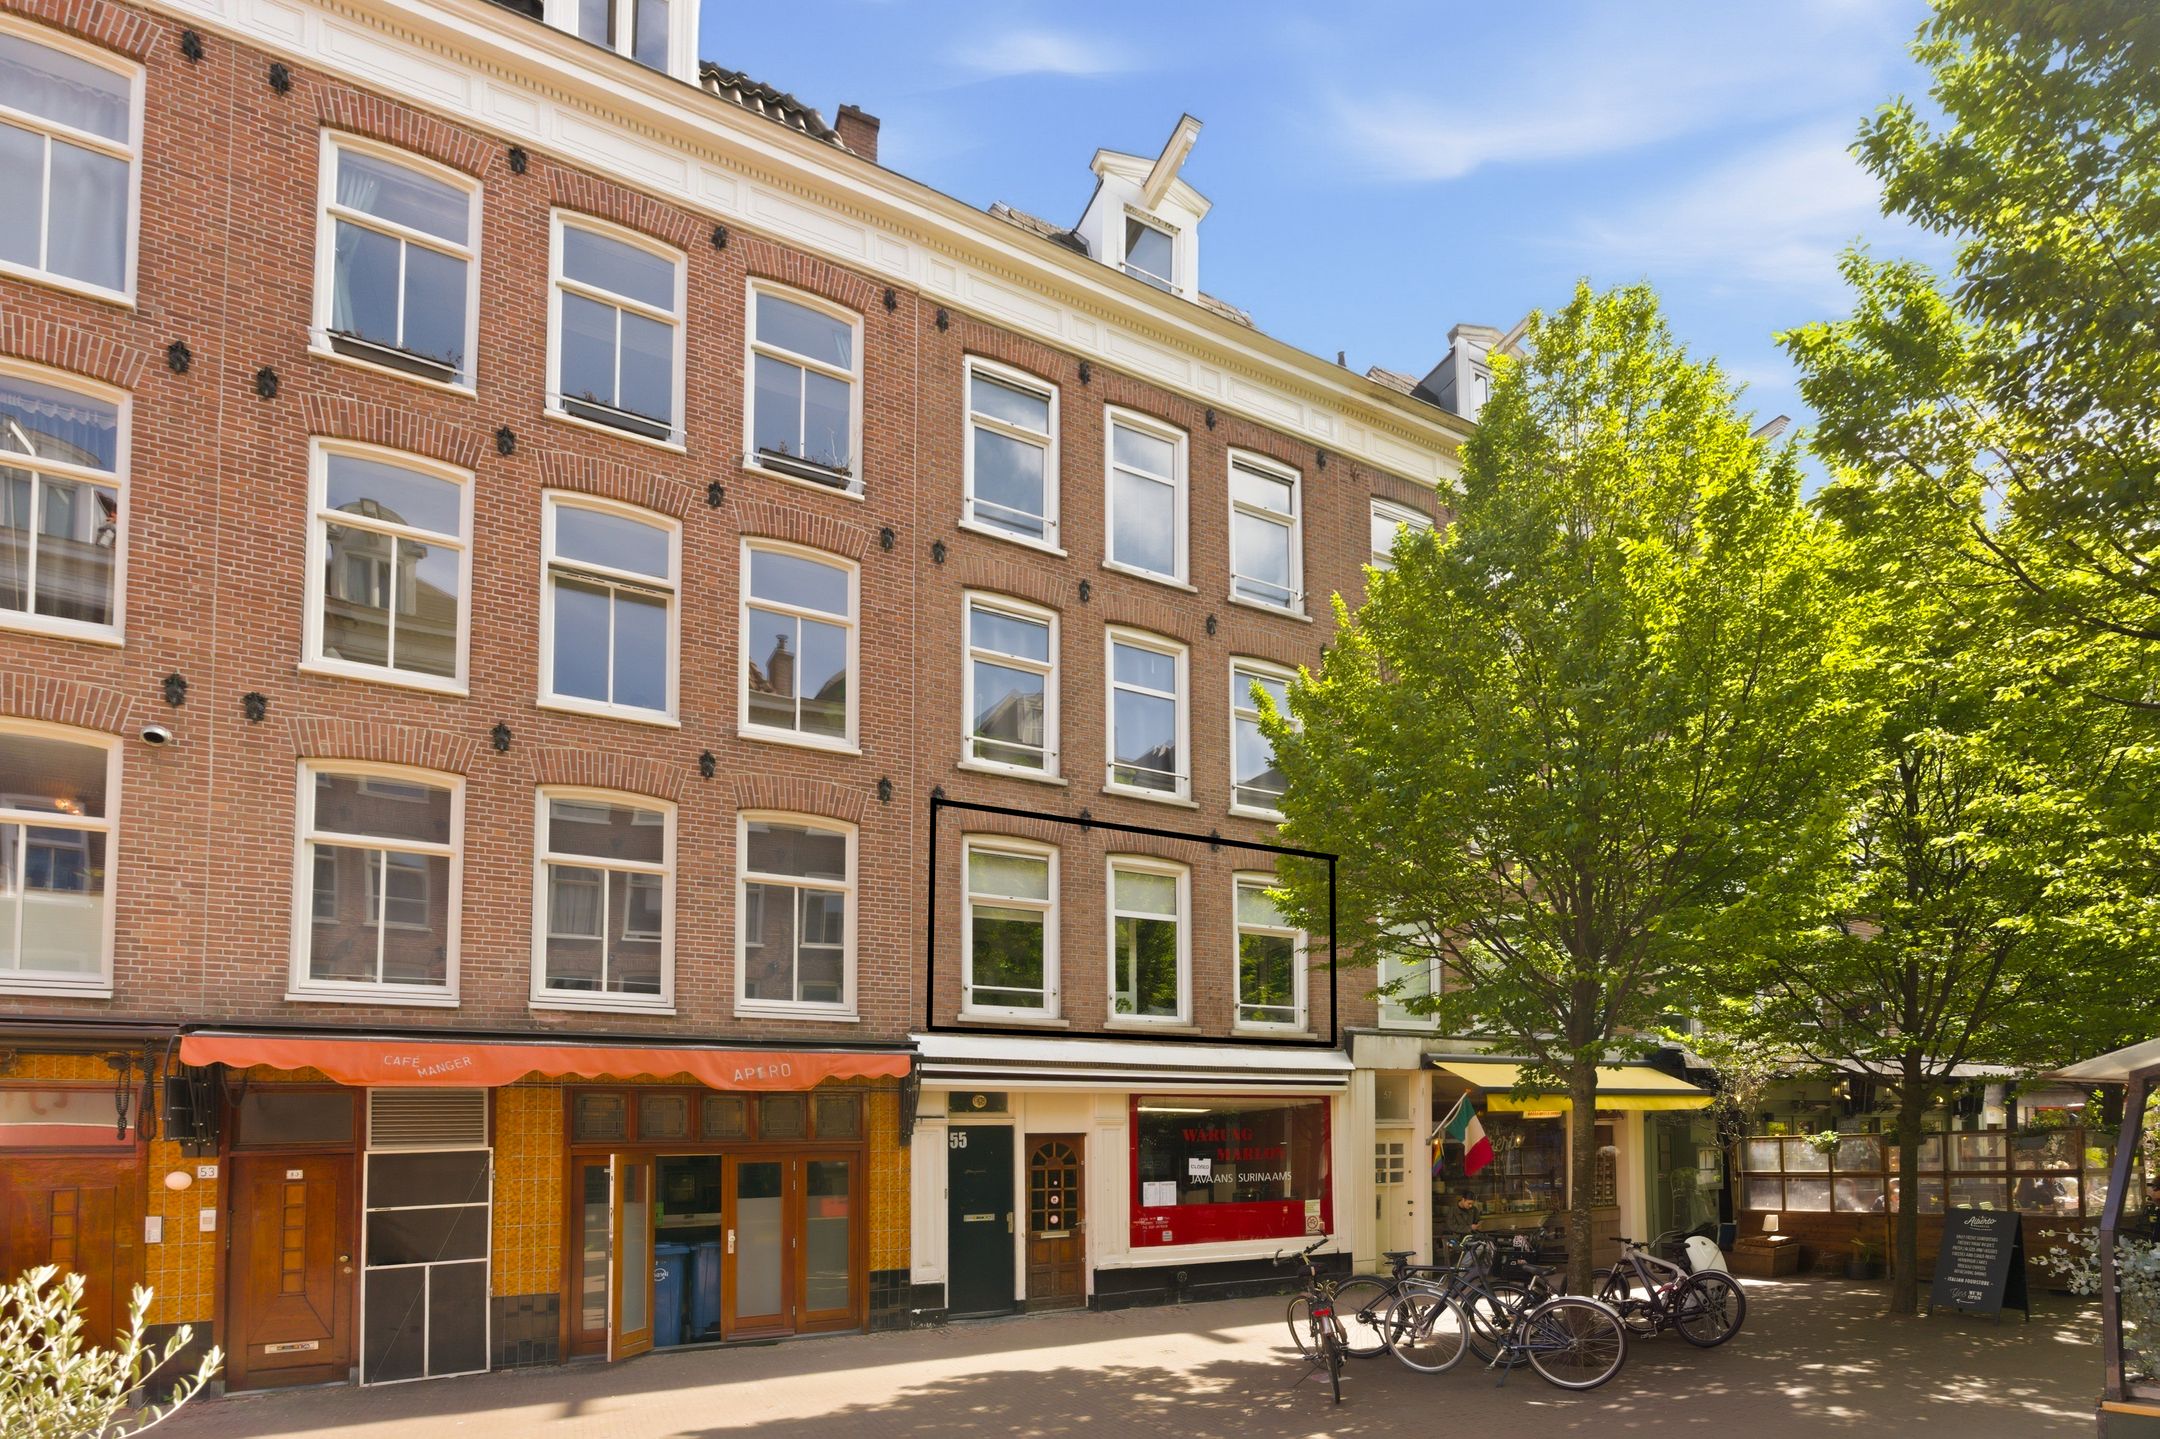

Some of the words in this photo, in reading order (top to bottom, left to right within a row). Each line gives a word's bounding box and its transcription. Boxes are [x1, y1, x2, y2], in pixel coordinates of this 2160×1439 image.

[417, 1056, 472, 1078] MANGER
[949, 1131, 968, 1149] 55
[200, 1167, 215, 1177] 53
[1190, 1173, 1234, 1185] JAVAANS
[1238, 1171, 1293, 1183] SURINAAMS
[1963, 1215, 1997, 1226] Alberto
